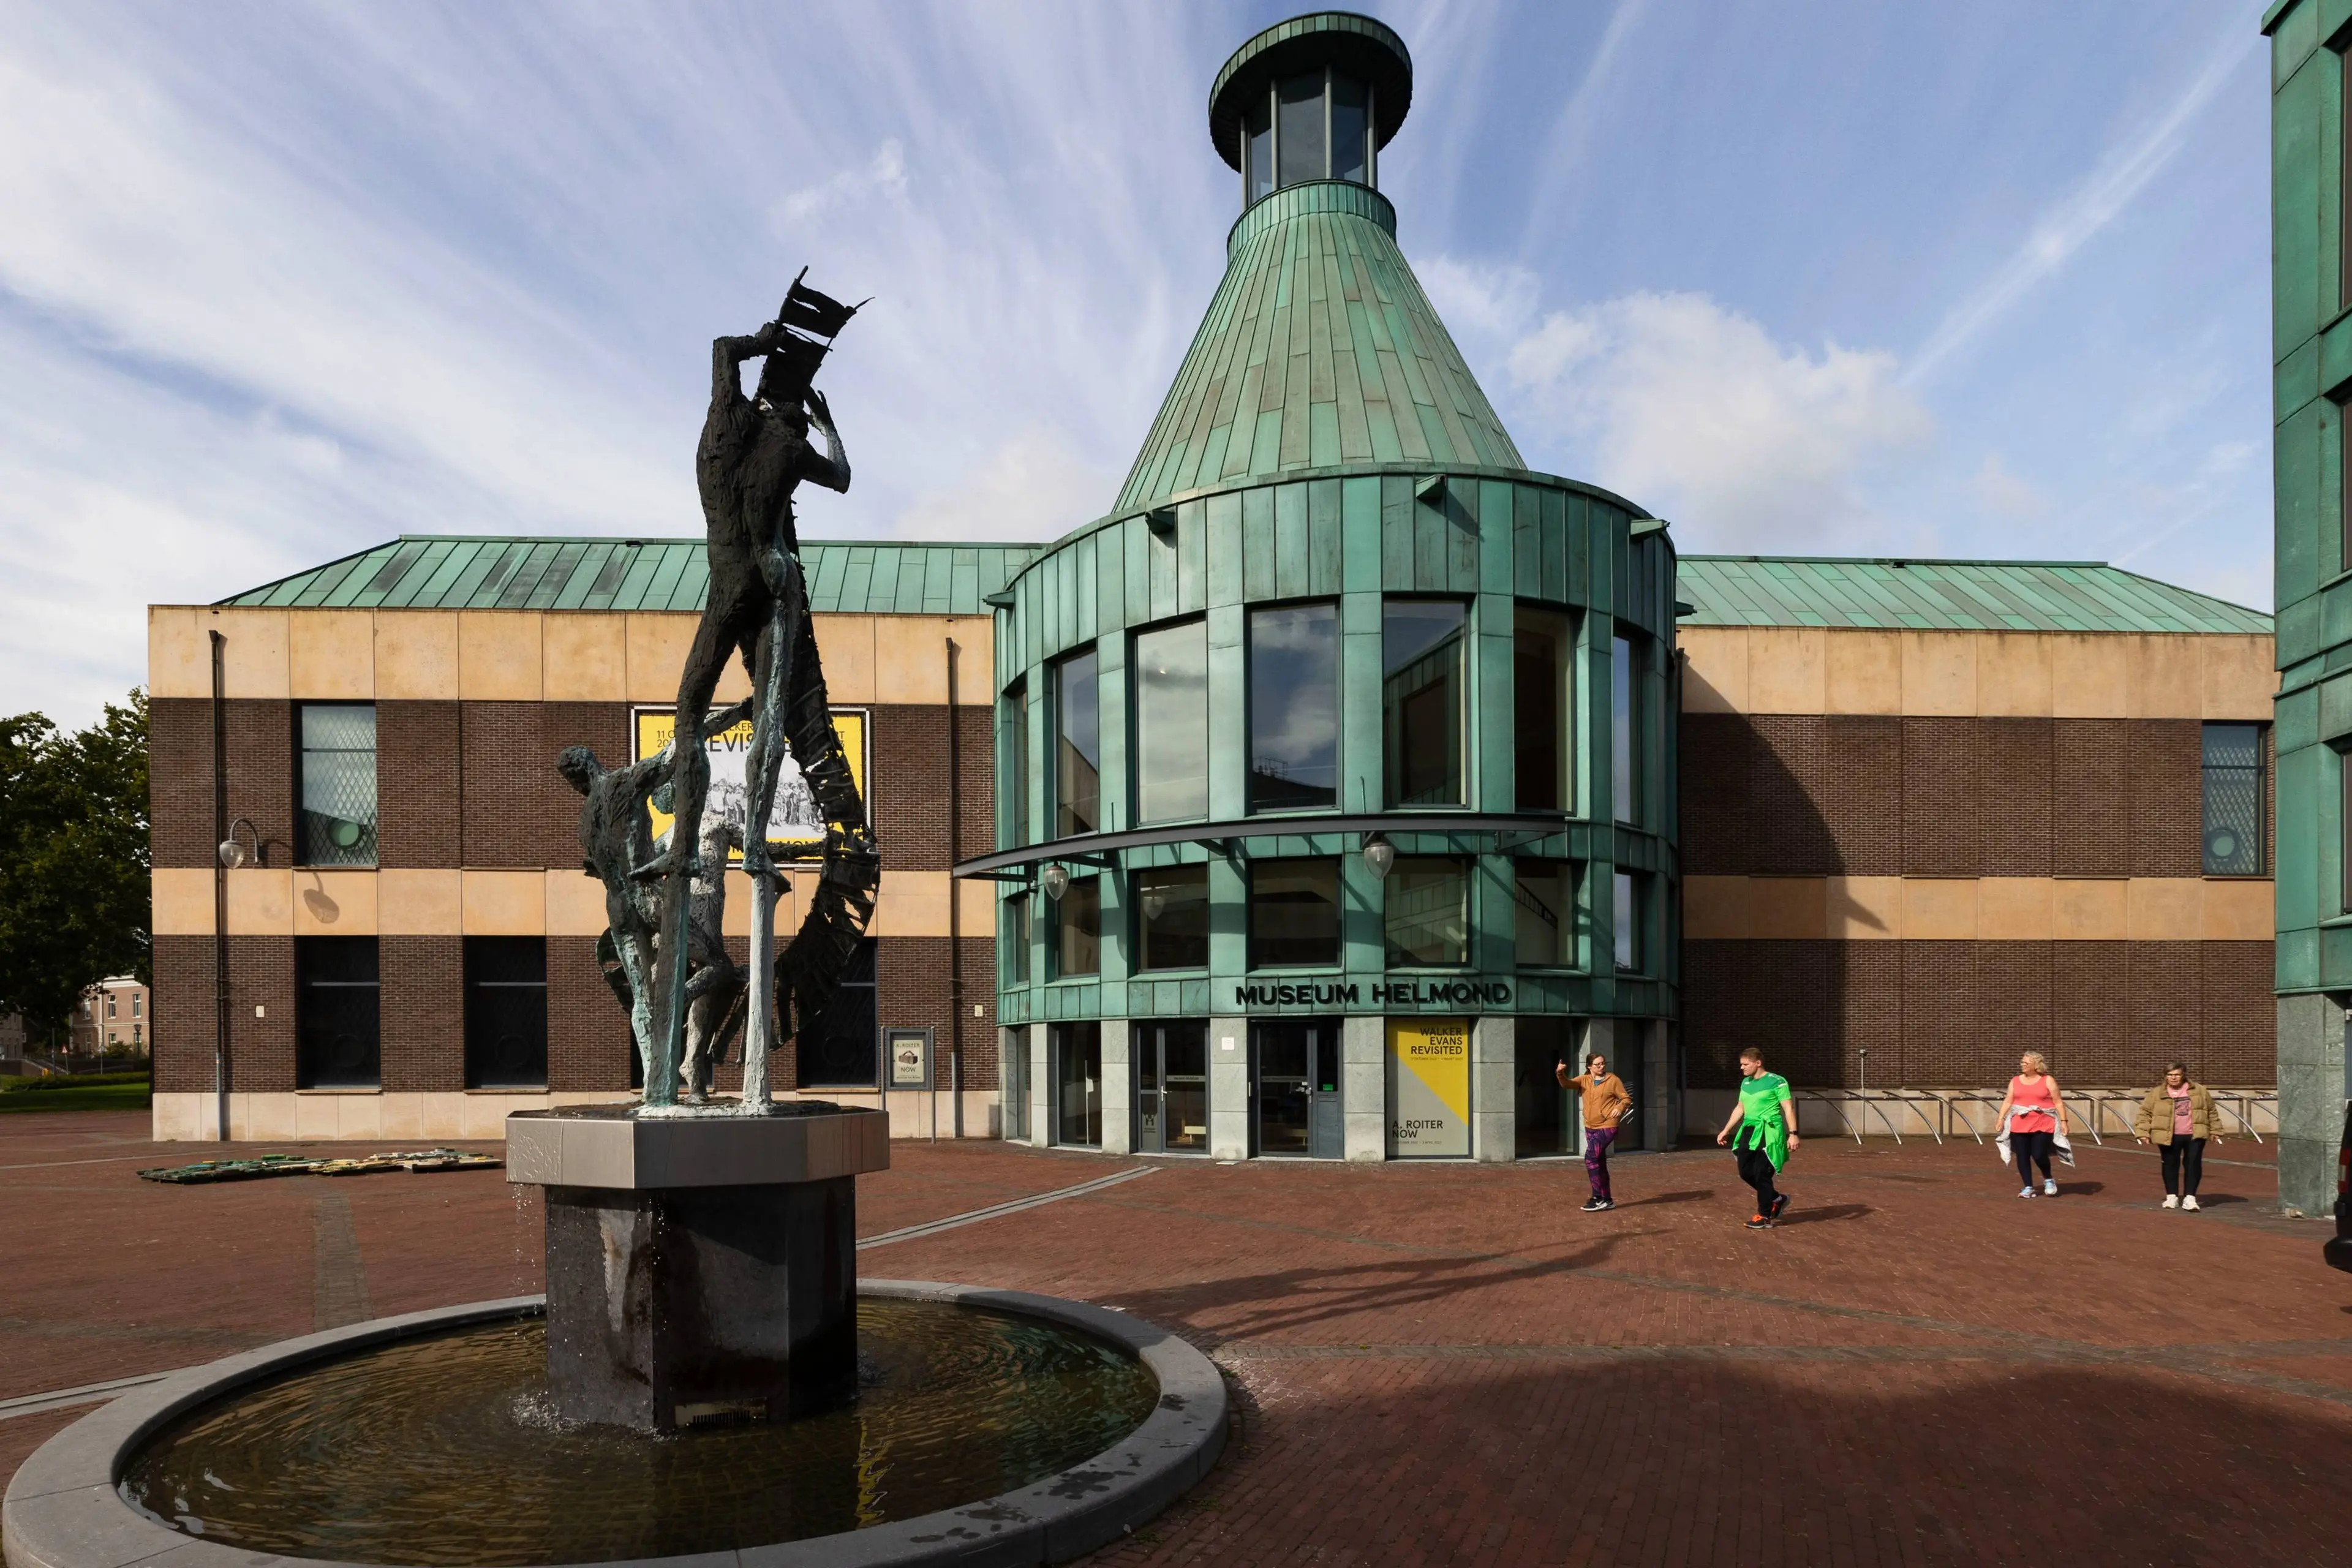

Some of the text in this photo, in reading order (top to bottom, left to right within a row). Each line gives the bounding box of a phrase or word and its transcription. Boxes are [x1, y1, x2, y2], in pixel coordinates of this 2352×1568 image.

[657, 730, 665, 739] 11
[1235, 982, 1512, 1006] MUSEUM HELMOND
[1420, 1027, 1463, 1036] WALKER
[1430, 1036, 1463, 1046] EVANS
[1411, 1046, 1463, 1055] REVISITED
[1392, 1120, 1444, 1129] A. ROITER
[1392, 1129, 1418, 1139] NOW
